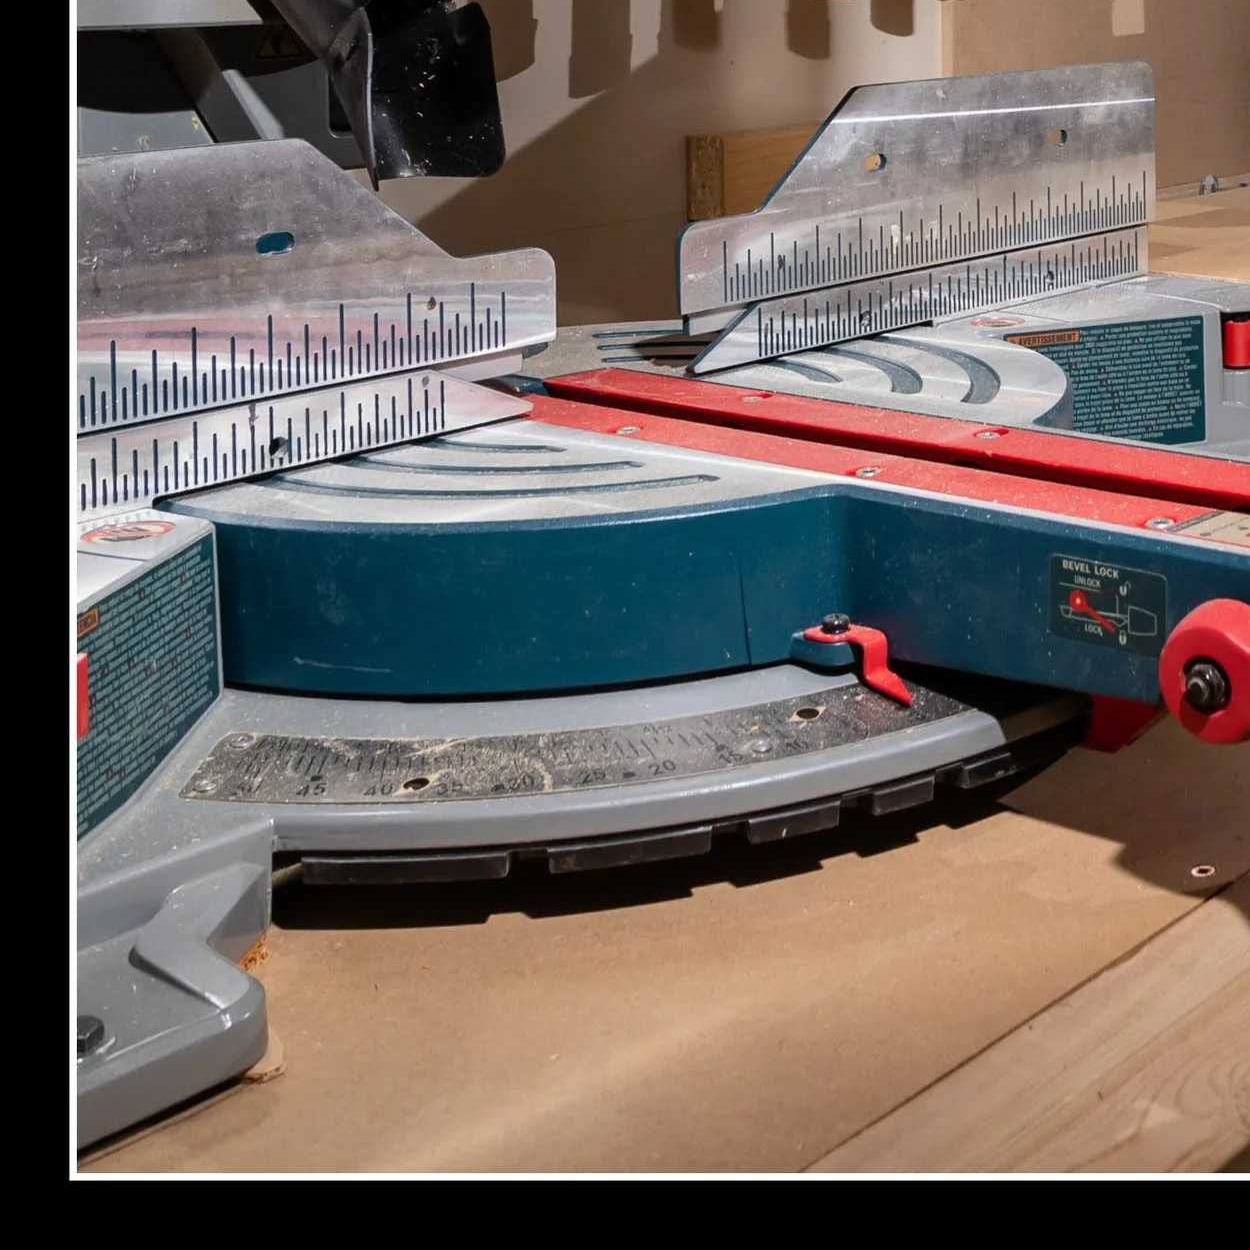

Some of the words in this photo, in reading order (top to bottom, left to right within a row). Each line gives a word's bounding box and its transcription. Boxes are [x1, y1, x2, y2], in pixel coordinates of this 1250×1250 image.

[1062, 559, 1091, 574] BEVEL
[1094, 565, 1119, 579] LOCK
[1074, 575, 1101, 588] UNLOCK
[1084, 624, 1103, 636] LOCK
[296, 782, 327, 797] 45
[363, 782, 393, 797] 40
[648, 760, 676, 776] 20
